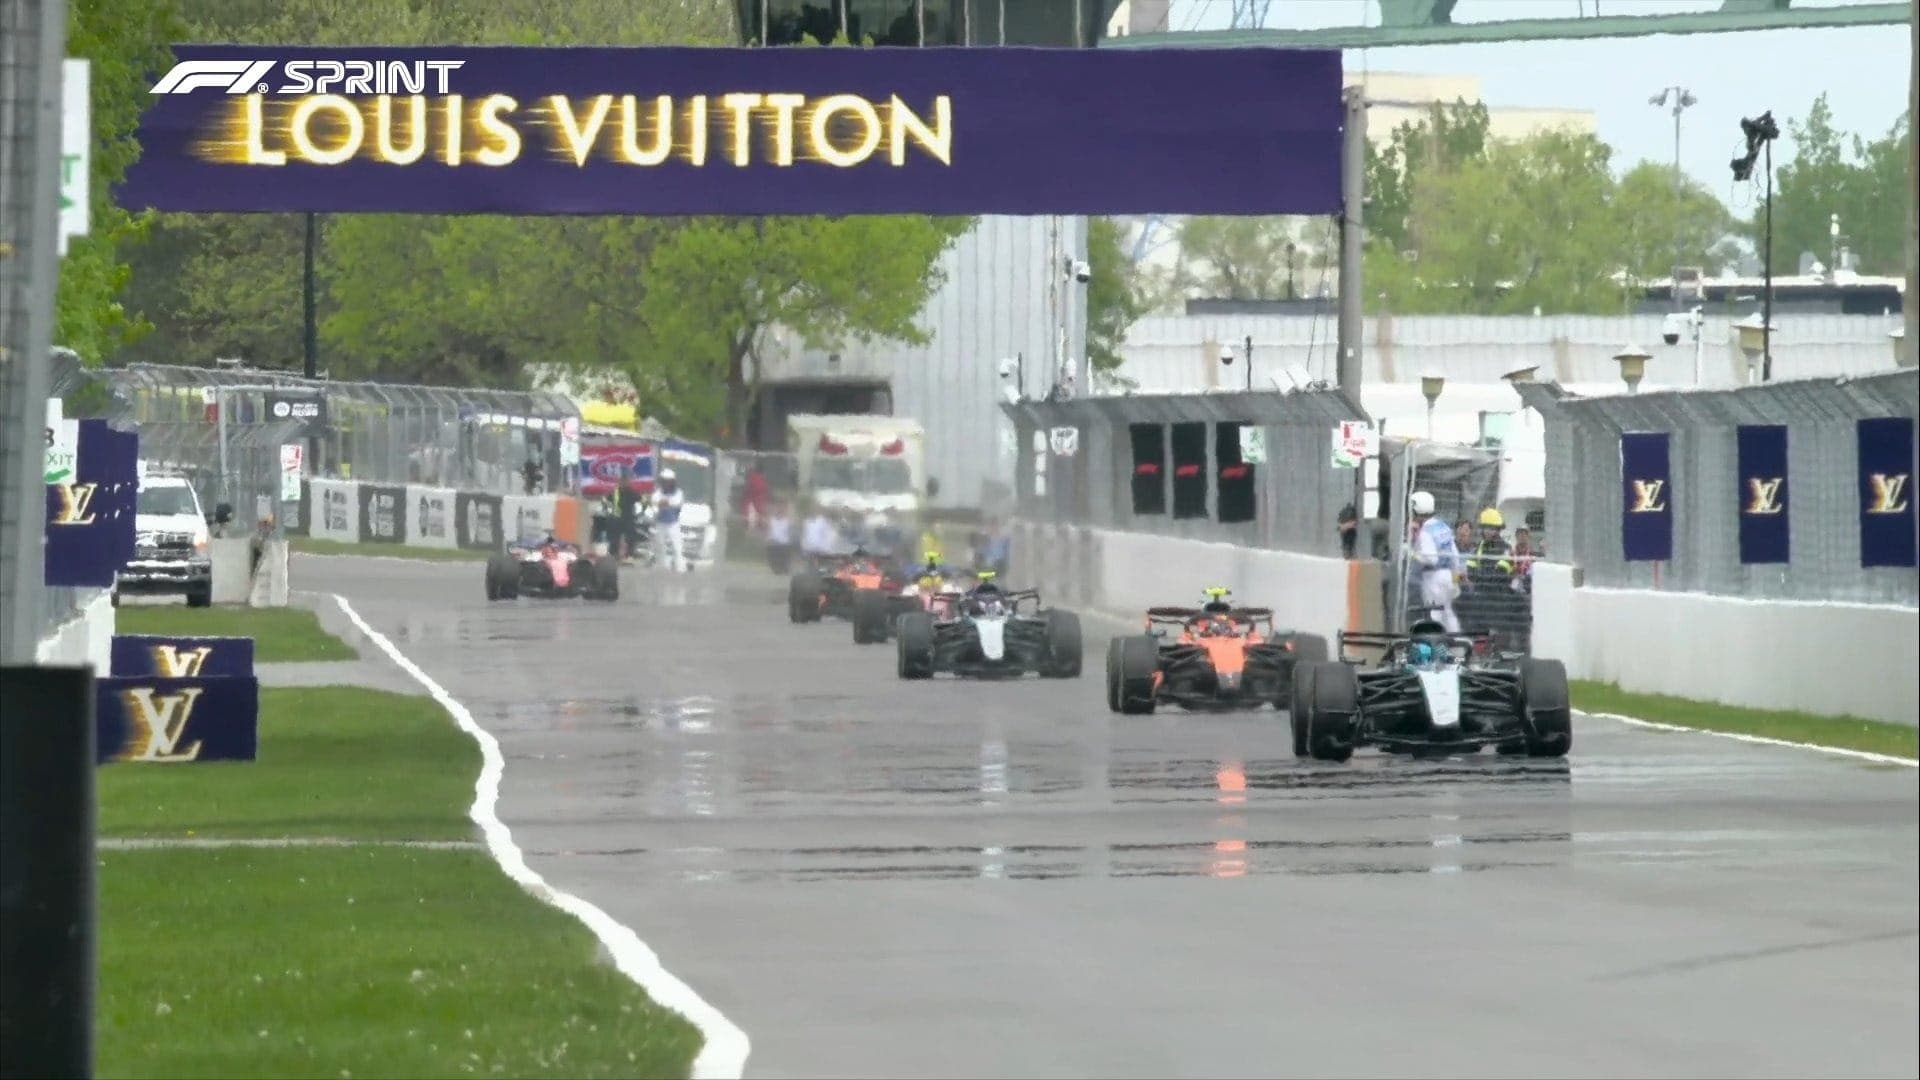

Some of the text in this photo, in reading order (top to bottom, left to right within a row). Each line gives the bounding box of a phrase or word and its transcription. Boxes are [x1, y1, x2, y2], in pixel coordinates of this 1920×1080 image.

[246, 93, 951, 167] LOUIS VUITTON
[1631, 479, 1665, 513] LV
[1747, 478, 1784, 514] LV
[1868, 473, 1908, 514] LV
[122, 687, 203, 762] LV
